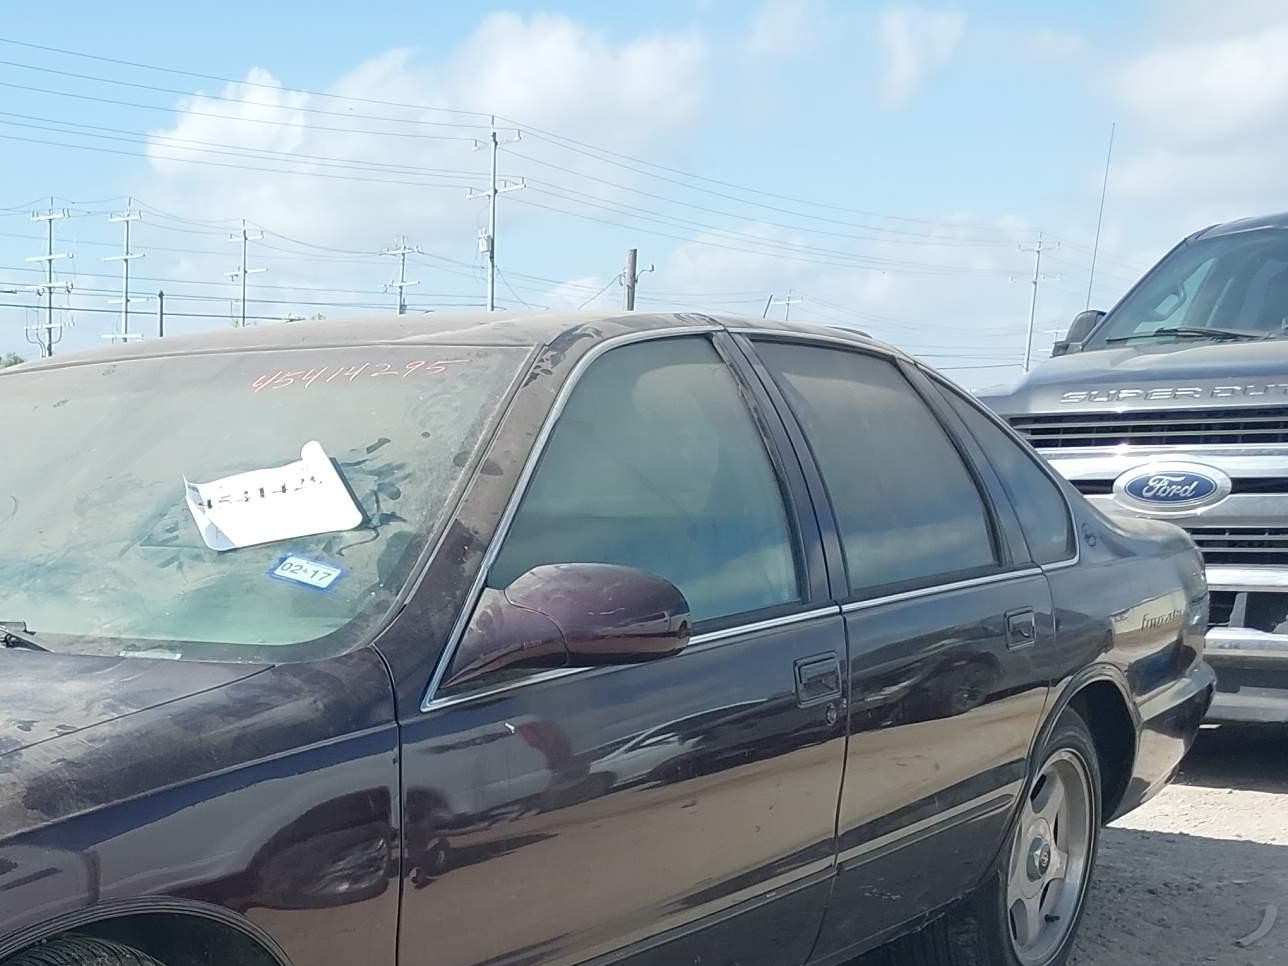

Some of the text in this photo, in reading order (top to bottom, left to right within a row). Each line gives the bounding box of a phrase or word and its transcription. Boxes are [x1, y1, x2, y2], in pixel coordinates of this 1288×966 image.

[252, 359, 470, 393] 45414295
[1060, 387, 1202, 403] SUPER
[1142, 475, 1199, 498] Ford
